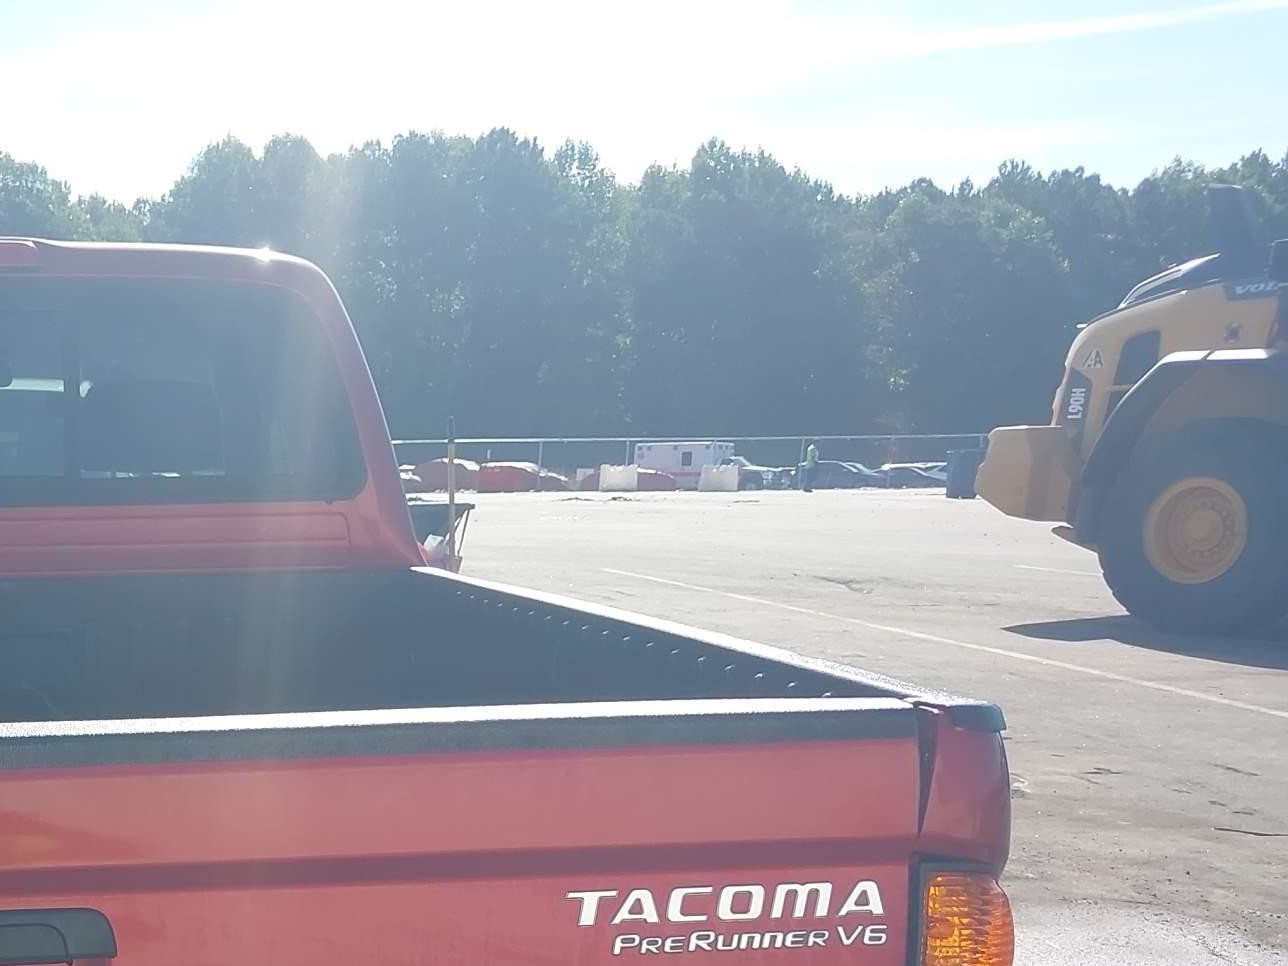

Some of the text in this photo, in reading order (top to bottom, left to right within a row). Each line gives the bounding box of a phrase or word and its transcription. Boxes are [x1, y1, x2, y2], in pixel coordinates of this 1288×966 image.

[1066, 387, 1086, 419] L90H
[566, 880, 884, 927] TACOMA
[836, 925, 888, 946] V6
